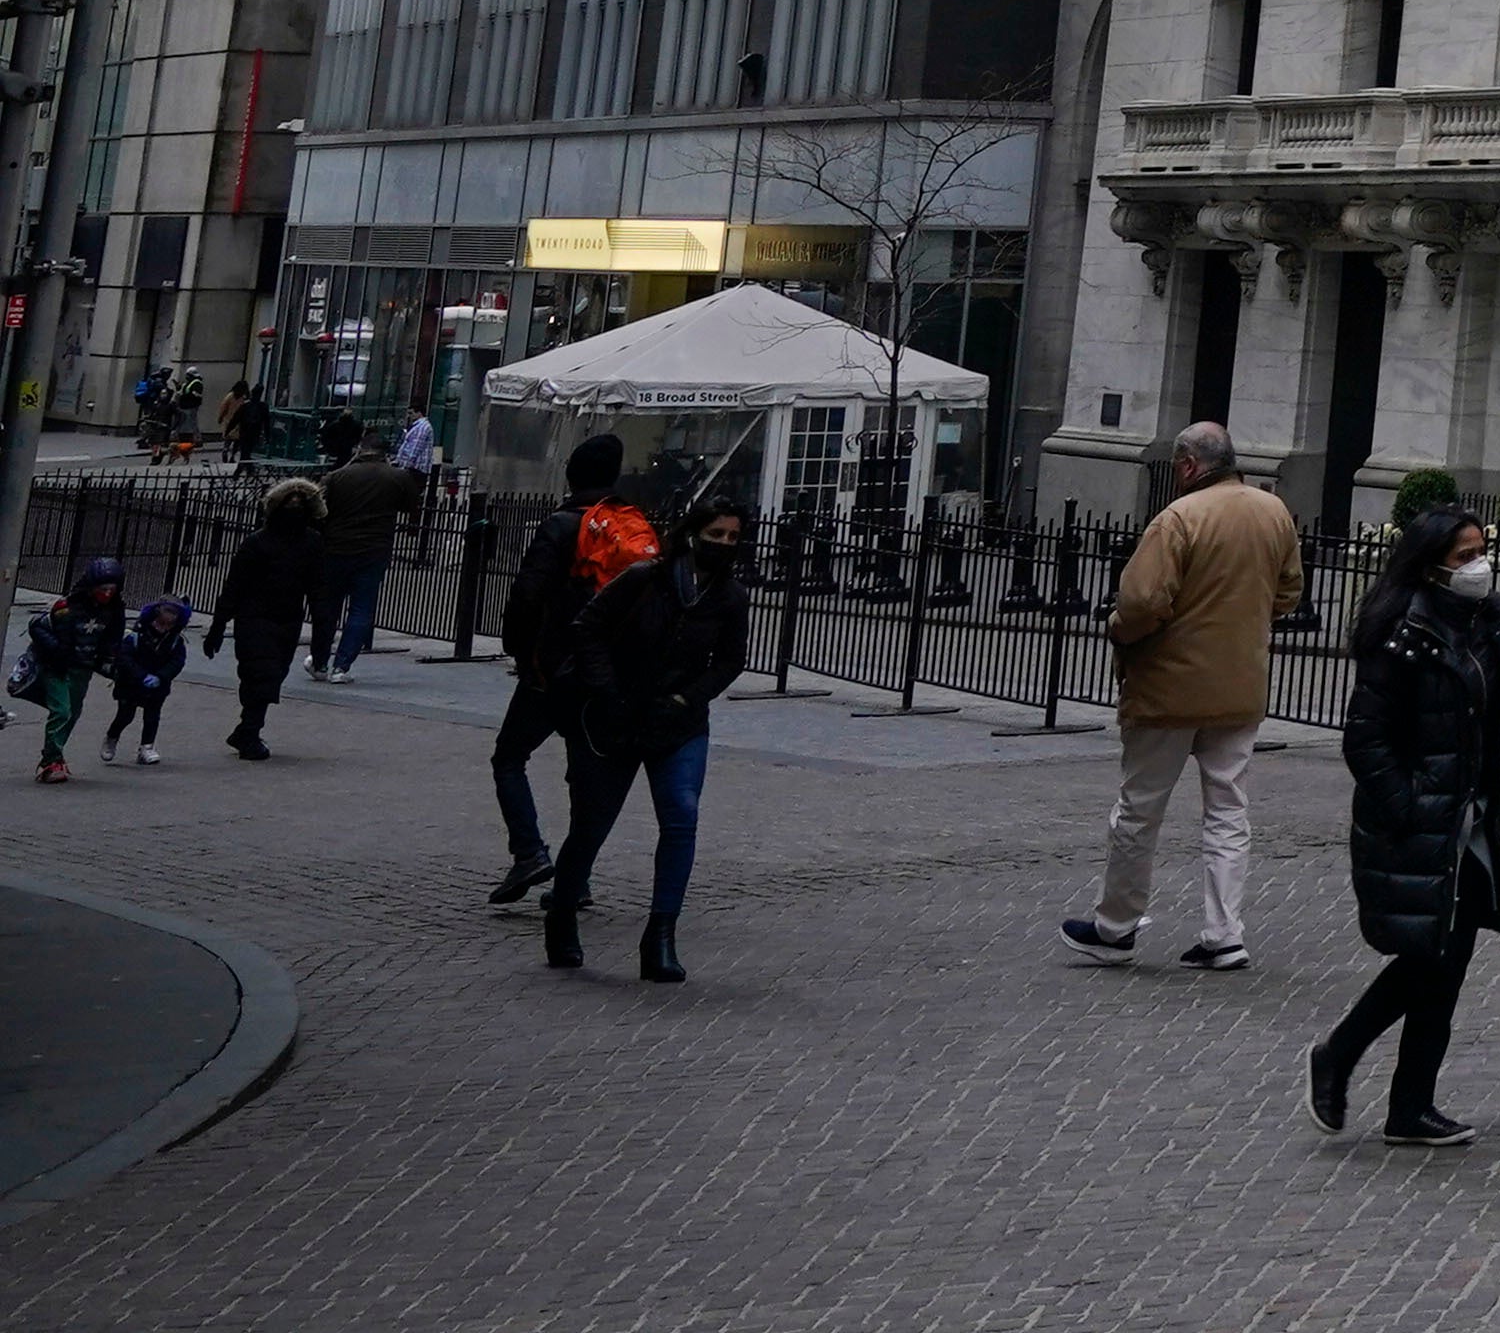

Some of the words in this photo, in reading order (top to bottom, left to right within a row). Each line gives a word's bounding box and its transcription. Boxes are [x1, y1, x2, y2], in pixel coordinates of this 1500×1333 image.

[535, 237, 569, 250] TWENTY
[573, 237, 604, 250] BROAD
[639, 392, 653, 403] 18
[656, 392, 697, 403] Broad
[699, 392, 738, 403] Street
